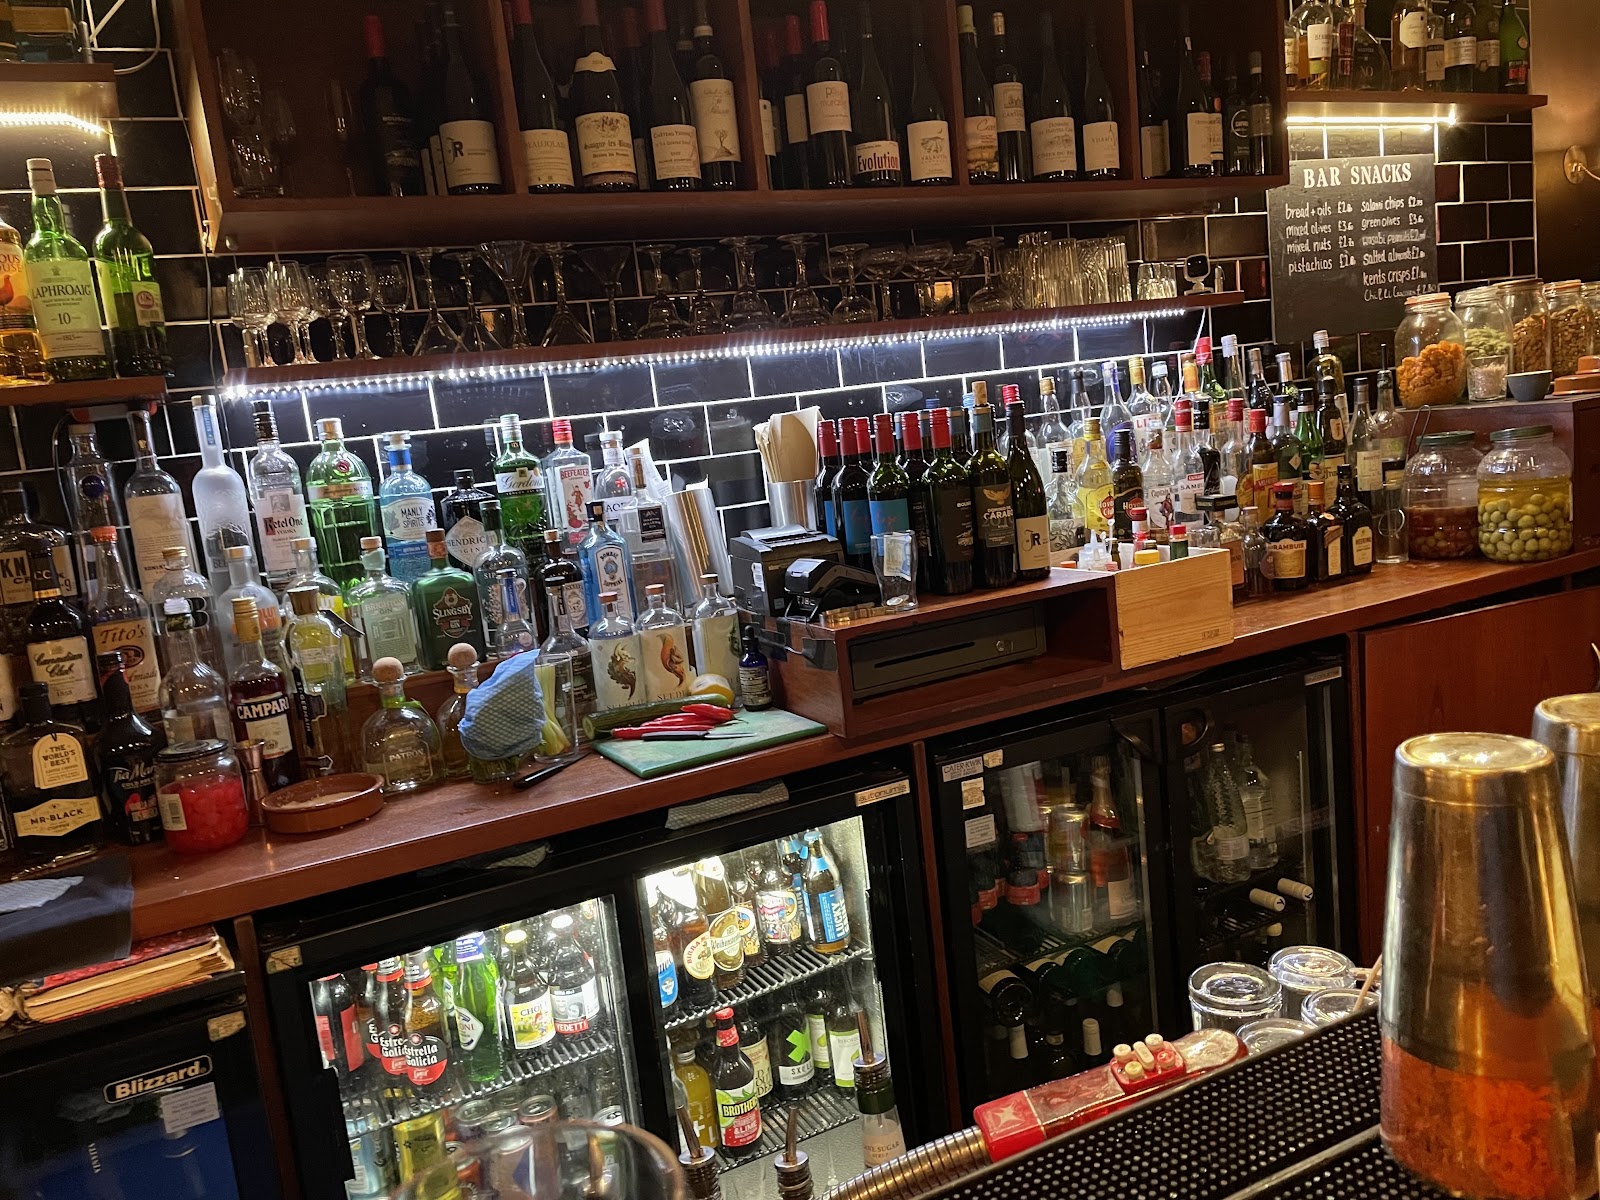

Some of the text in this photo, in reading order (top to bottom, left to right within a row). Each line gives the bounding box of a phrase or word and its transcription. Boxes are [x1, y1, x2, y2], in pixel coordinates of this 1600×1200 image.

[858, 151, 899, 171] Evolution
[1303, 162, 1412, 189] BAR SNACKS
[1285, 202, 1309, 220] bread
[1316, 201, 1332, 216] oils
[1384, 196, 1404, 210] chips
[1286, 221, 1310, 238] mixed
[1310, 222, 1332, 234] olives
[1361, 218, 1380, 231] green
[1381, 216, 1401, 227] olives
[1286, 239, 1311, 254] mixed
[1313, 238, 1332, 252] nuts
[0, 254, 21, 264] OUS
[1288, 256, 1333, 276] pistachios
[32, 284, 92, 299] LAPHROAIG
[58, 312, 71, 325] 10
[560, 468, 590, 480] BEEFEATER
[401, 506, 423, 519] MANLY
[403, 518, 425, 529] SPIRITS
[0, 557, 27, 578] KN
[365, 598, 405, 611] BRIGHTON
[433, 602, 472, 620] SLINGSBY
[100, 624, 146, 644] Tito's
[46, 663, 75, 678] Club
[236, 696, 290, 720] CAMPARI
[42, 750, 76, 761] WORLD'S
[49, 744, 66, 752] THE
[50, 758, 71, 767] BEST
[831, 902, 846, 938] LUCKY
[404, 1044, 438, 1057] Estrella
[406, 1055, 438, 1067] Galicia
[115, 1061, 201, 1100] Blizzard
